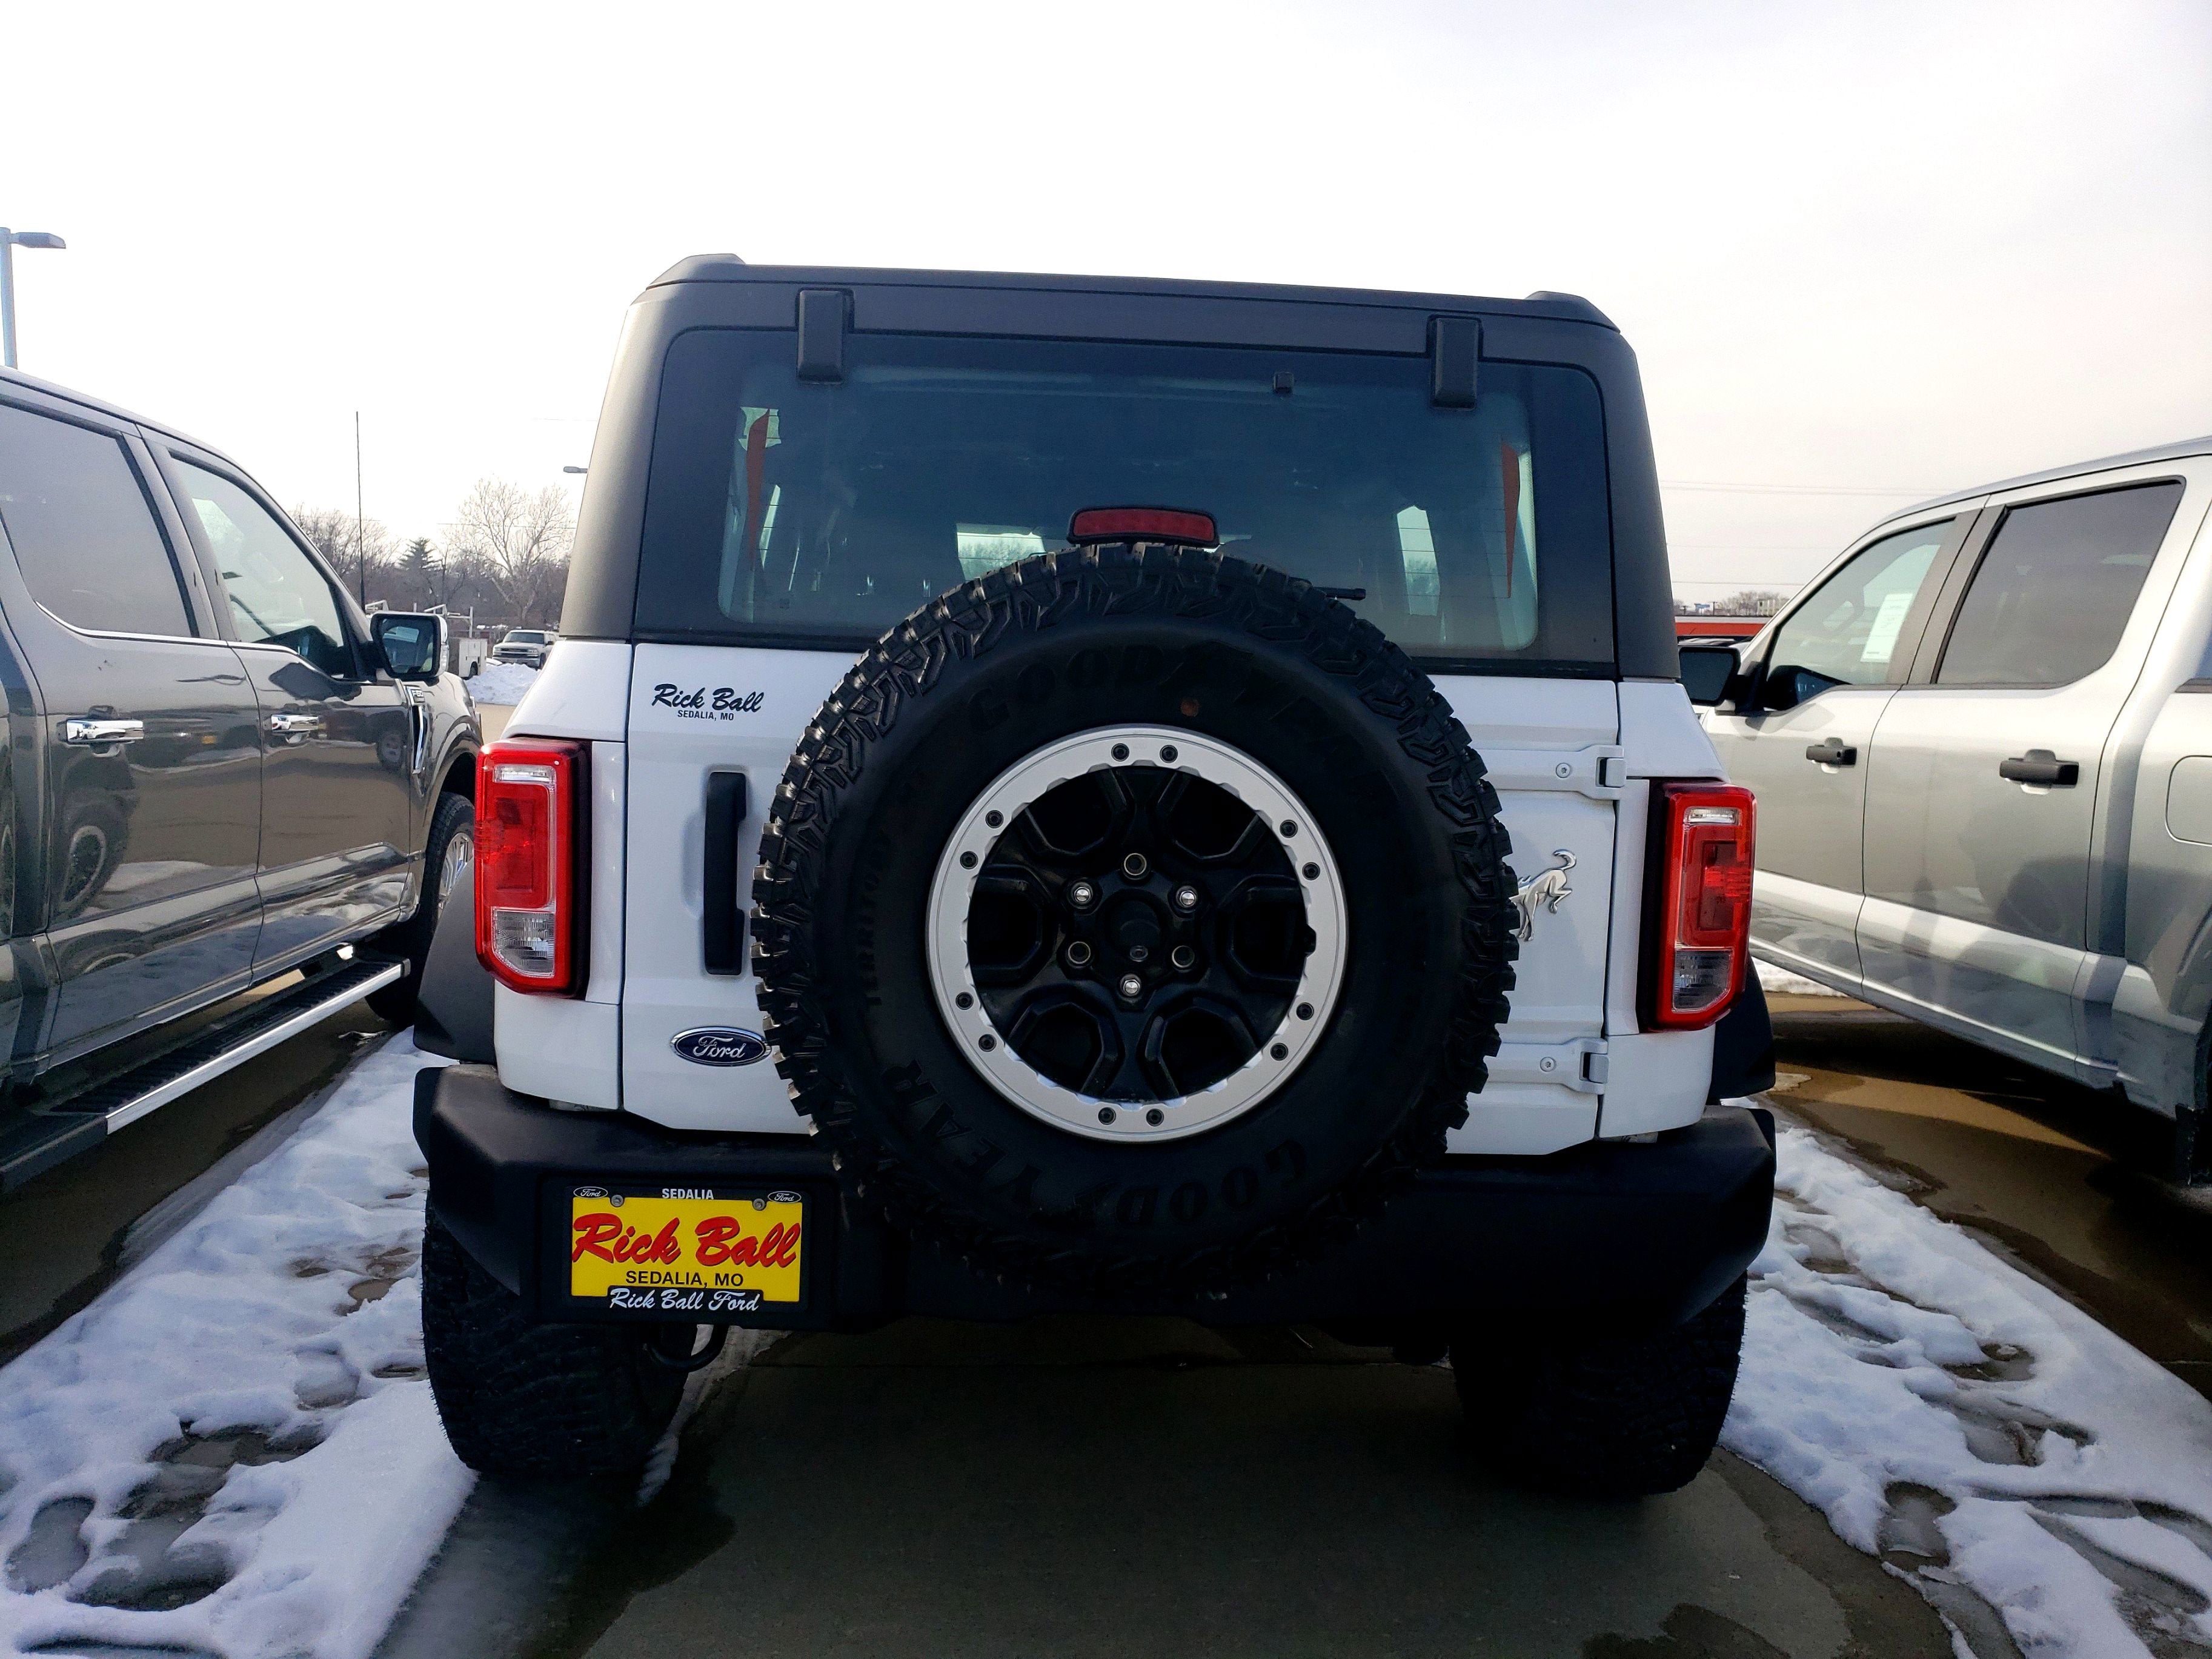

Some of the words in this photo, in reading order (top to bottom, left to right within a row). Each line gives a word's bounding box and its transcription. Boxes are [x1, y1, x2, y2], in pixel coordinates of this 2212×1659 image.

[651, 683, 706, 709] Rick
[712, 687, 764, 713] Ball
[677, 710, 717, 721] SEDALIA,
[693, 1036, 746, 1058] Ford
[662, 1188, 714, 1200] SEDALIA
[572, 1212, 682, 1265] Rick
[695, 1216, 800, 1268] Ball
[626, 1271, 708, 1288] SEDALIA,
[715, 1273, 744, 1286] MO
[609, 1288, 656, 1309] Rick
[661, 1289, 703, 1310] Ball
[708, 1291, 760, 1311] Ford
